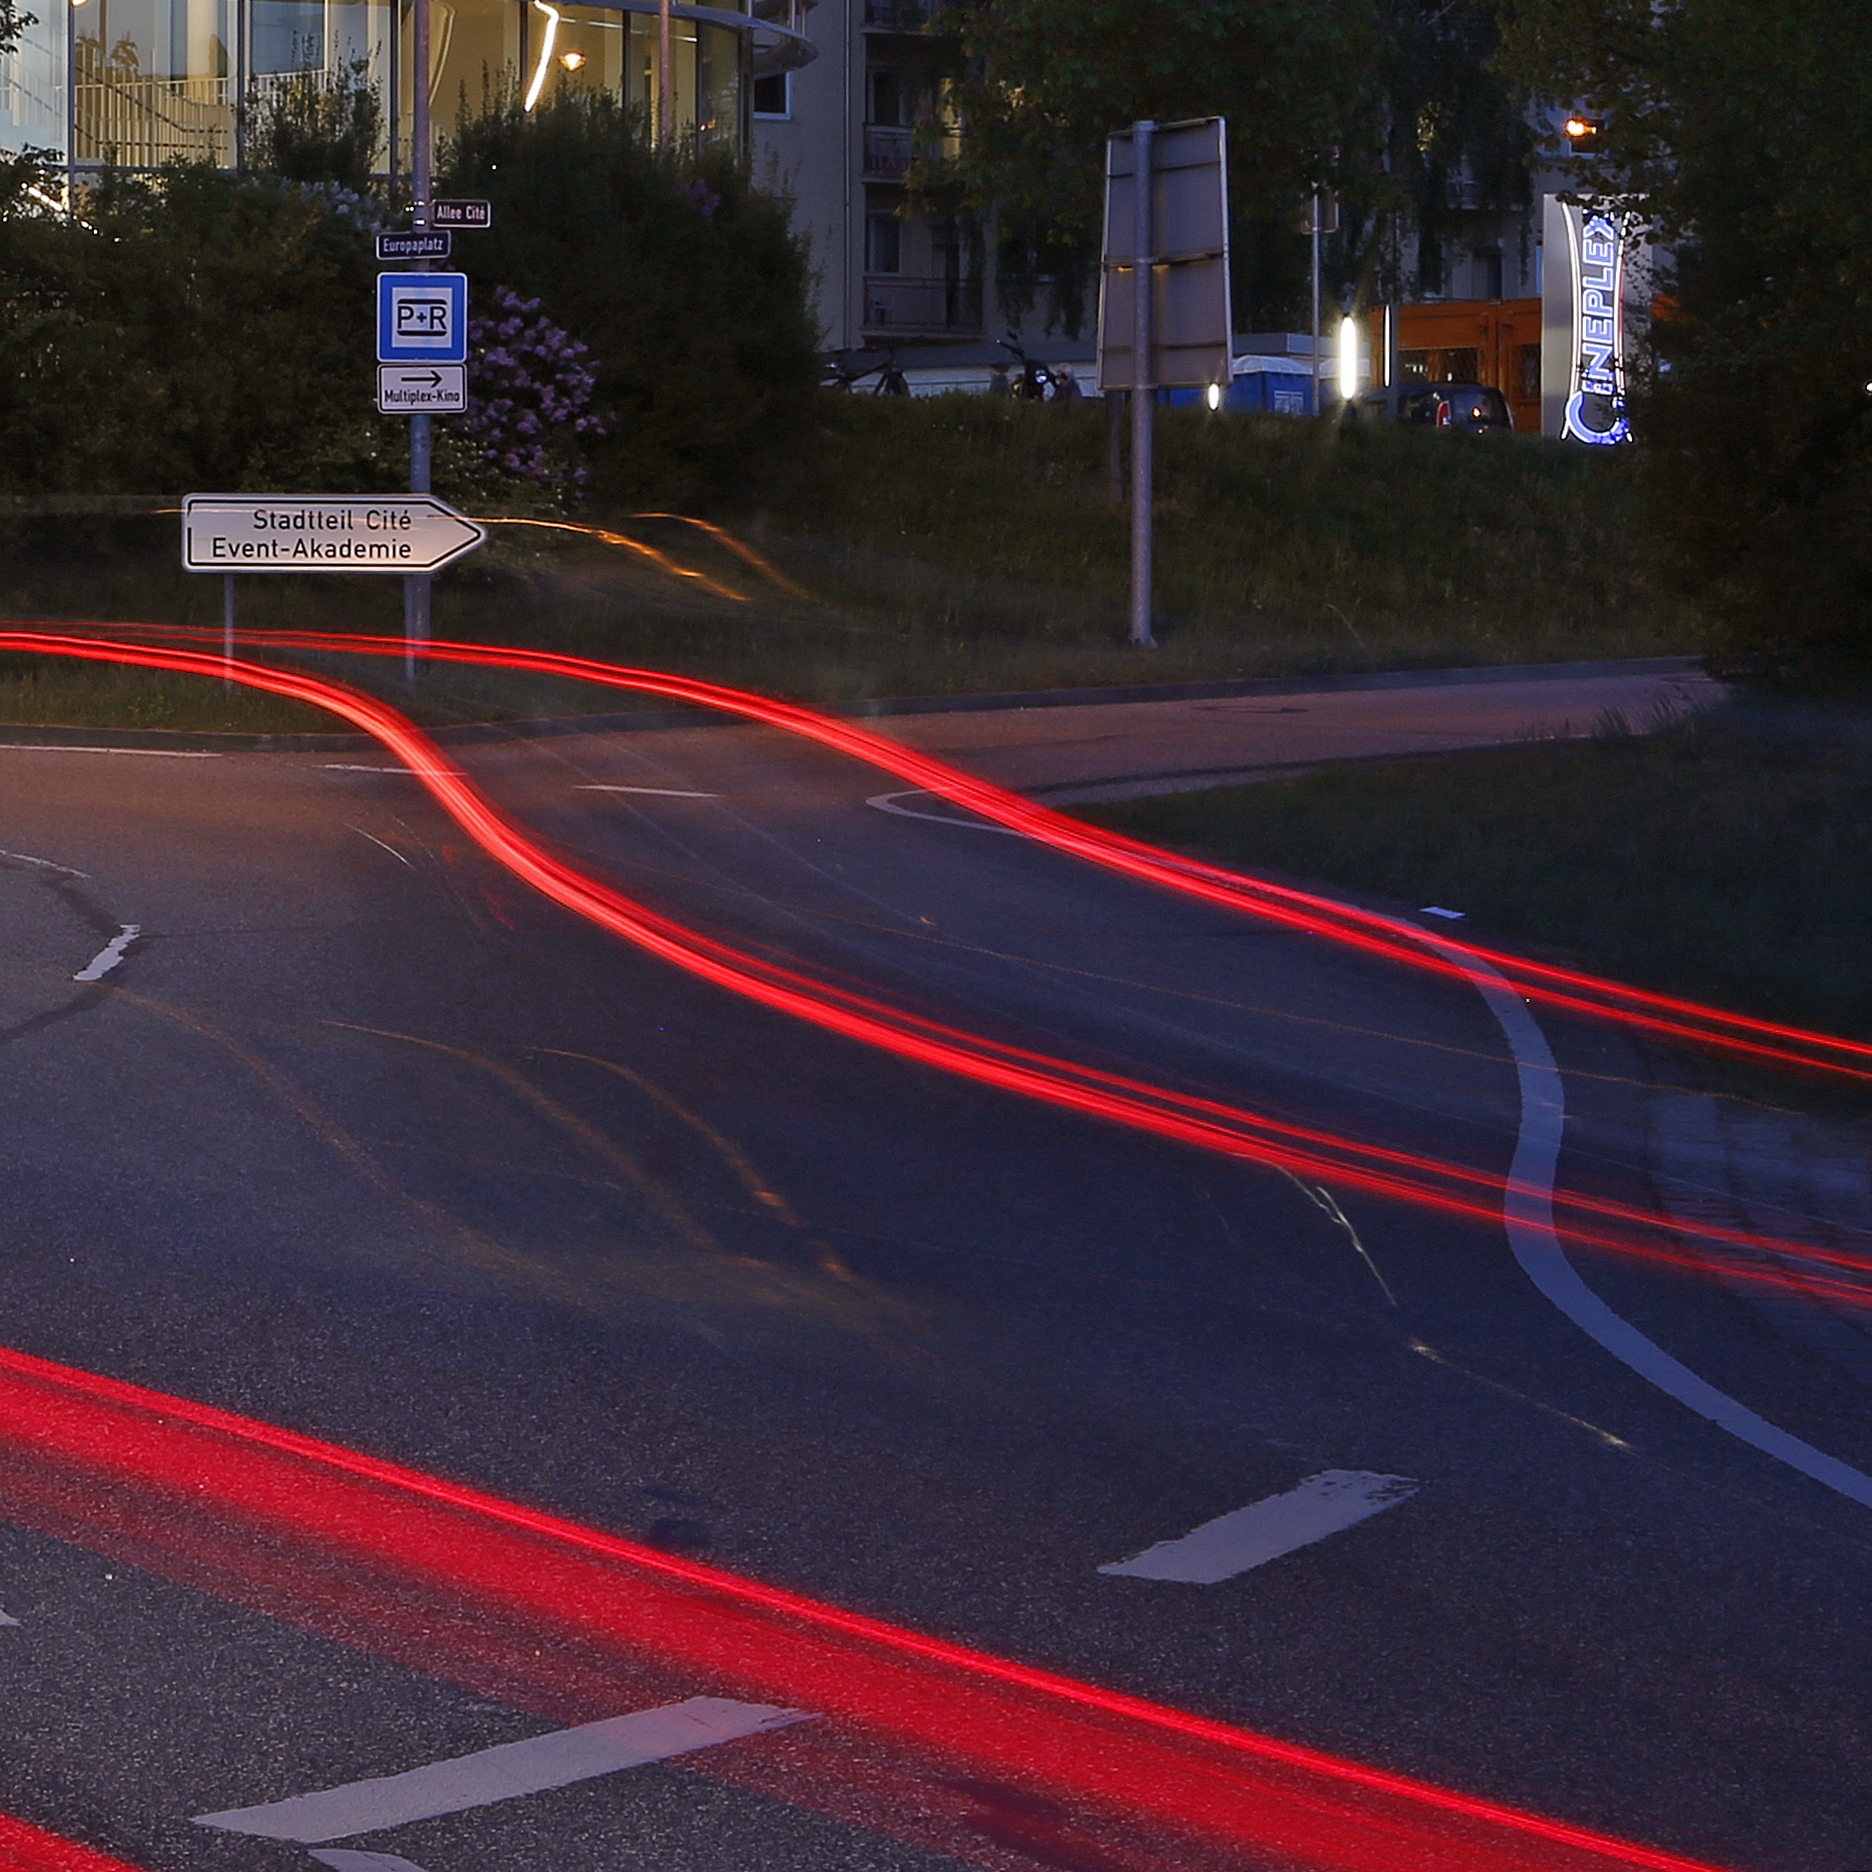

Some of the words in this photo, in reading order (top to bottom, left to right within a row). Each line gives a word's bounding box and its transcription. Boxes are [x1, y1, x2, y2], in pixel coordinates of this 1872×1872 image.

[436, 205, 462, 220] Allee
[465, 205, 486, 220] Cité
[383, 237, 444, 254] Europaplatz
[397, 305, 447, 330] P+R
[384, 389, 460, 405] Multiplex-Kino
[253, 509, 354, 530] Stadtteil
[366, 509, 412, 530] Cité
[212, 537, 412, 559] Event-Akademie
